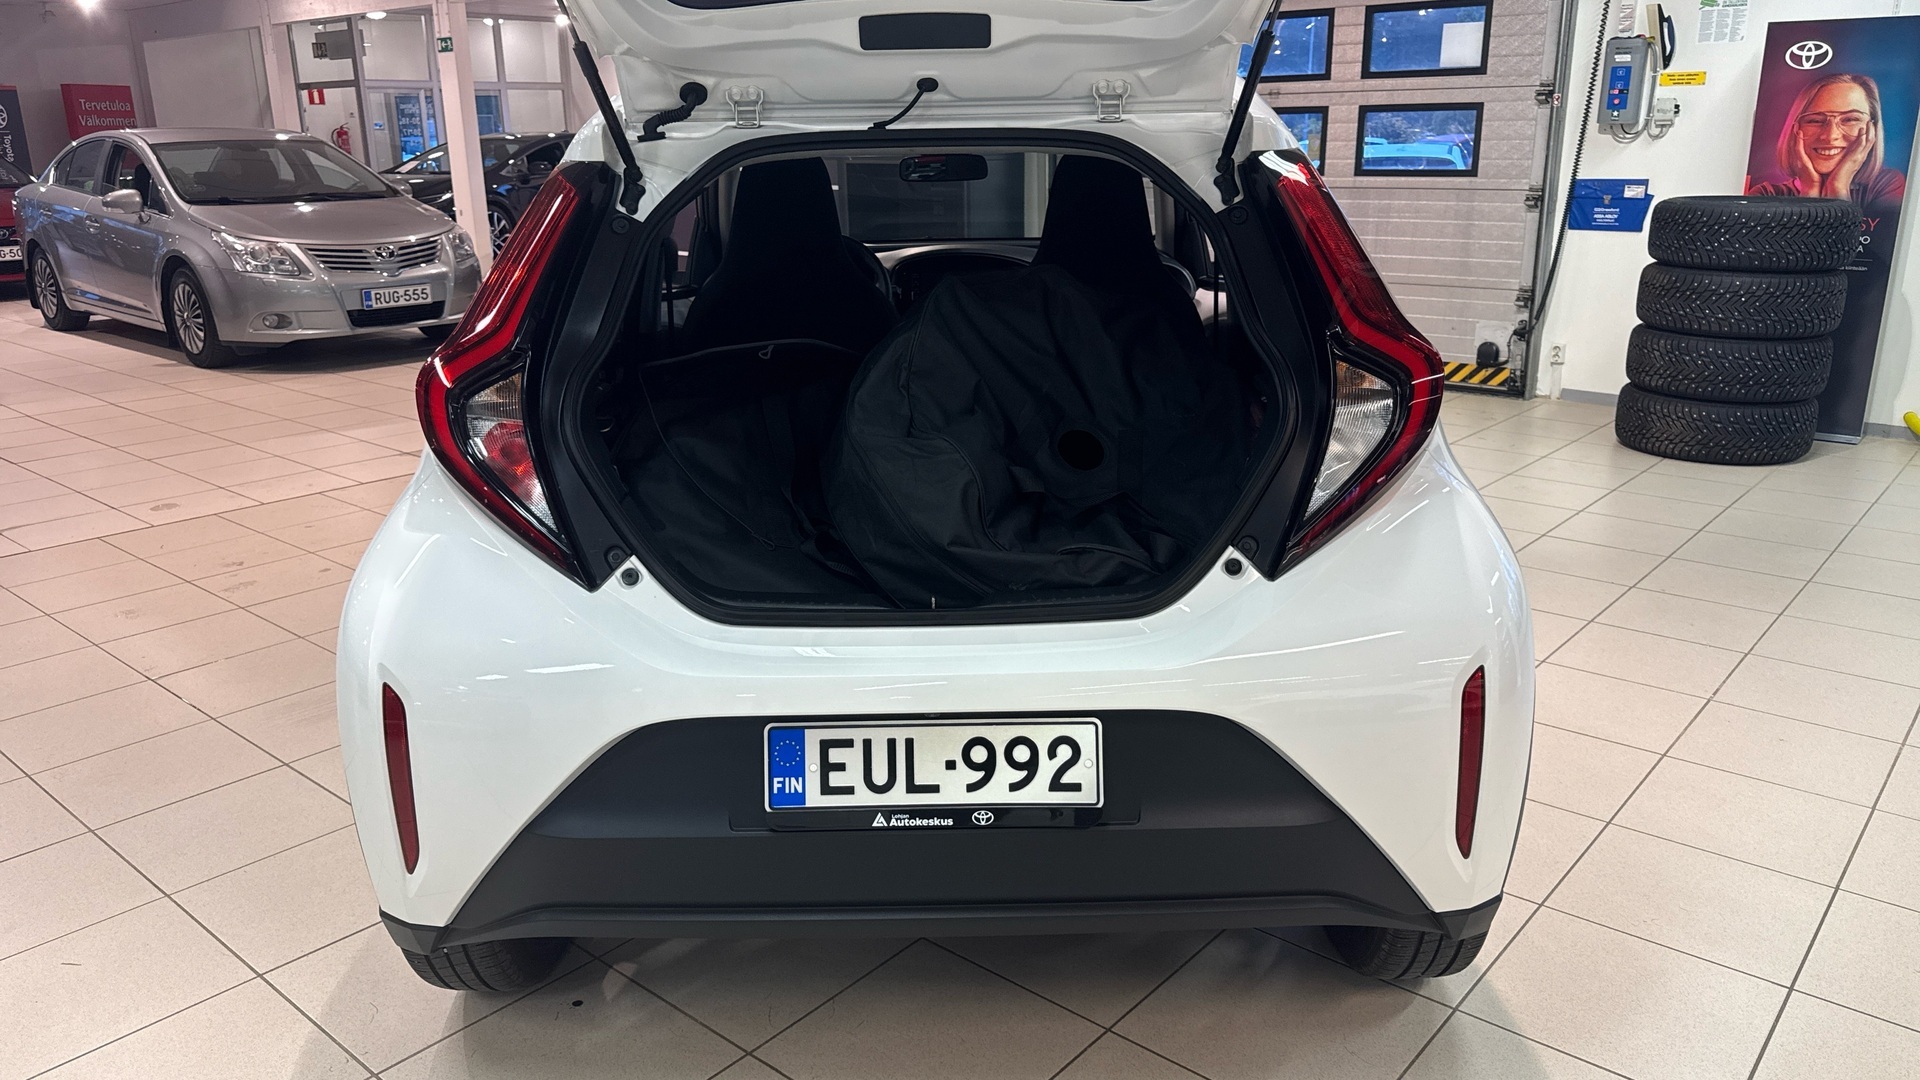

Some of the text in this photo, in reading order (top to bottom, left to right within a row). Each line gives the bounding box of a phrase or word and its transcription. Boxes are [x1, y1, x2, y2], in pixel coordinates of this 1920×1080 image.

[79, 99, 131, 111] Tervetuloa
[79, 115, 137, 127] Välkommen
[3, 135, 15, 162] Toyota
[773, 777, 803, 794] FIN
[889, 817, 954, 827] Autokeskus
